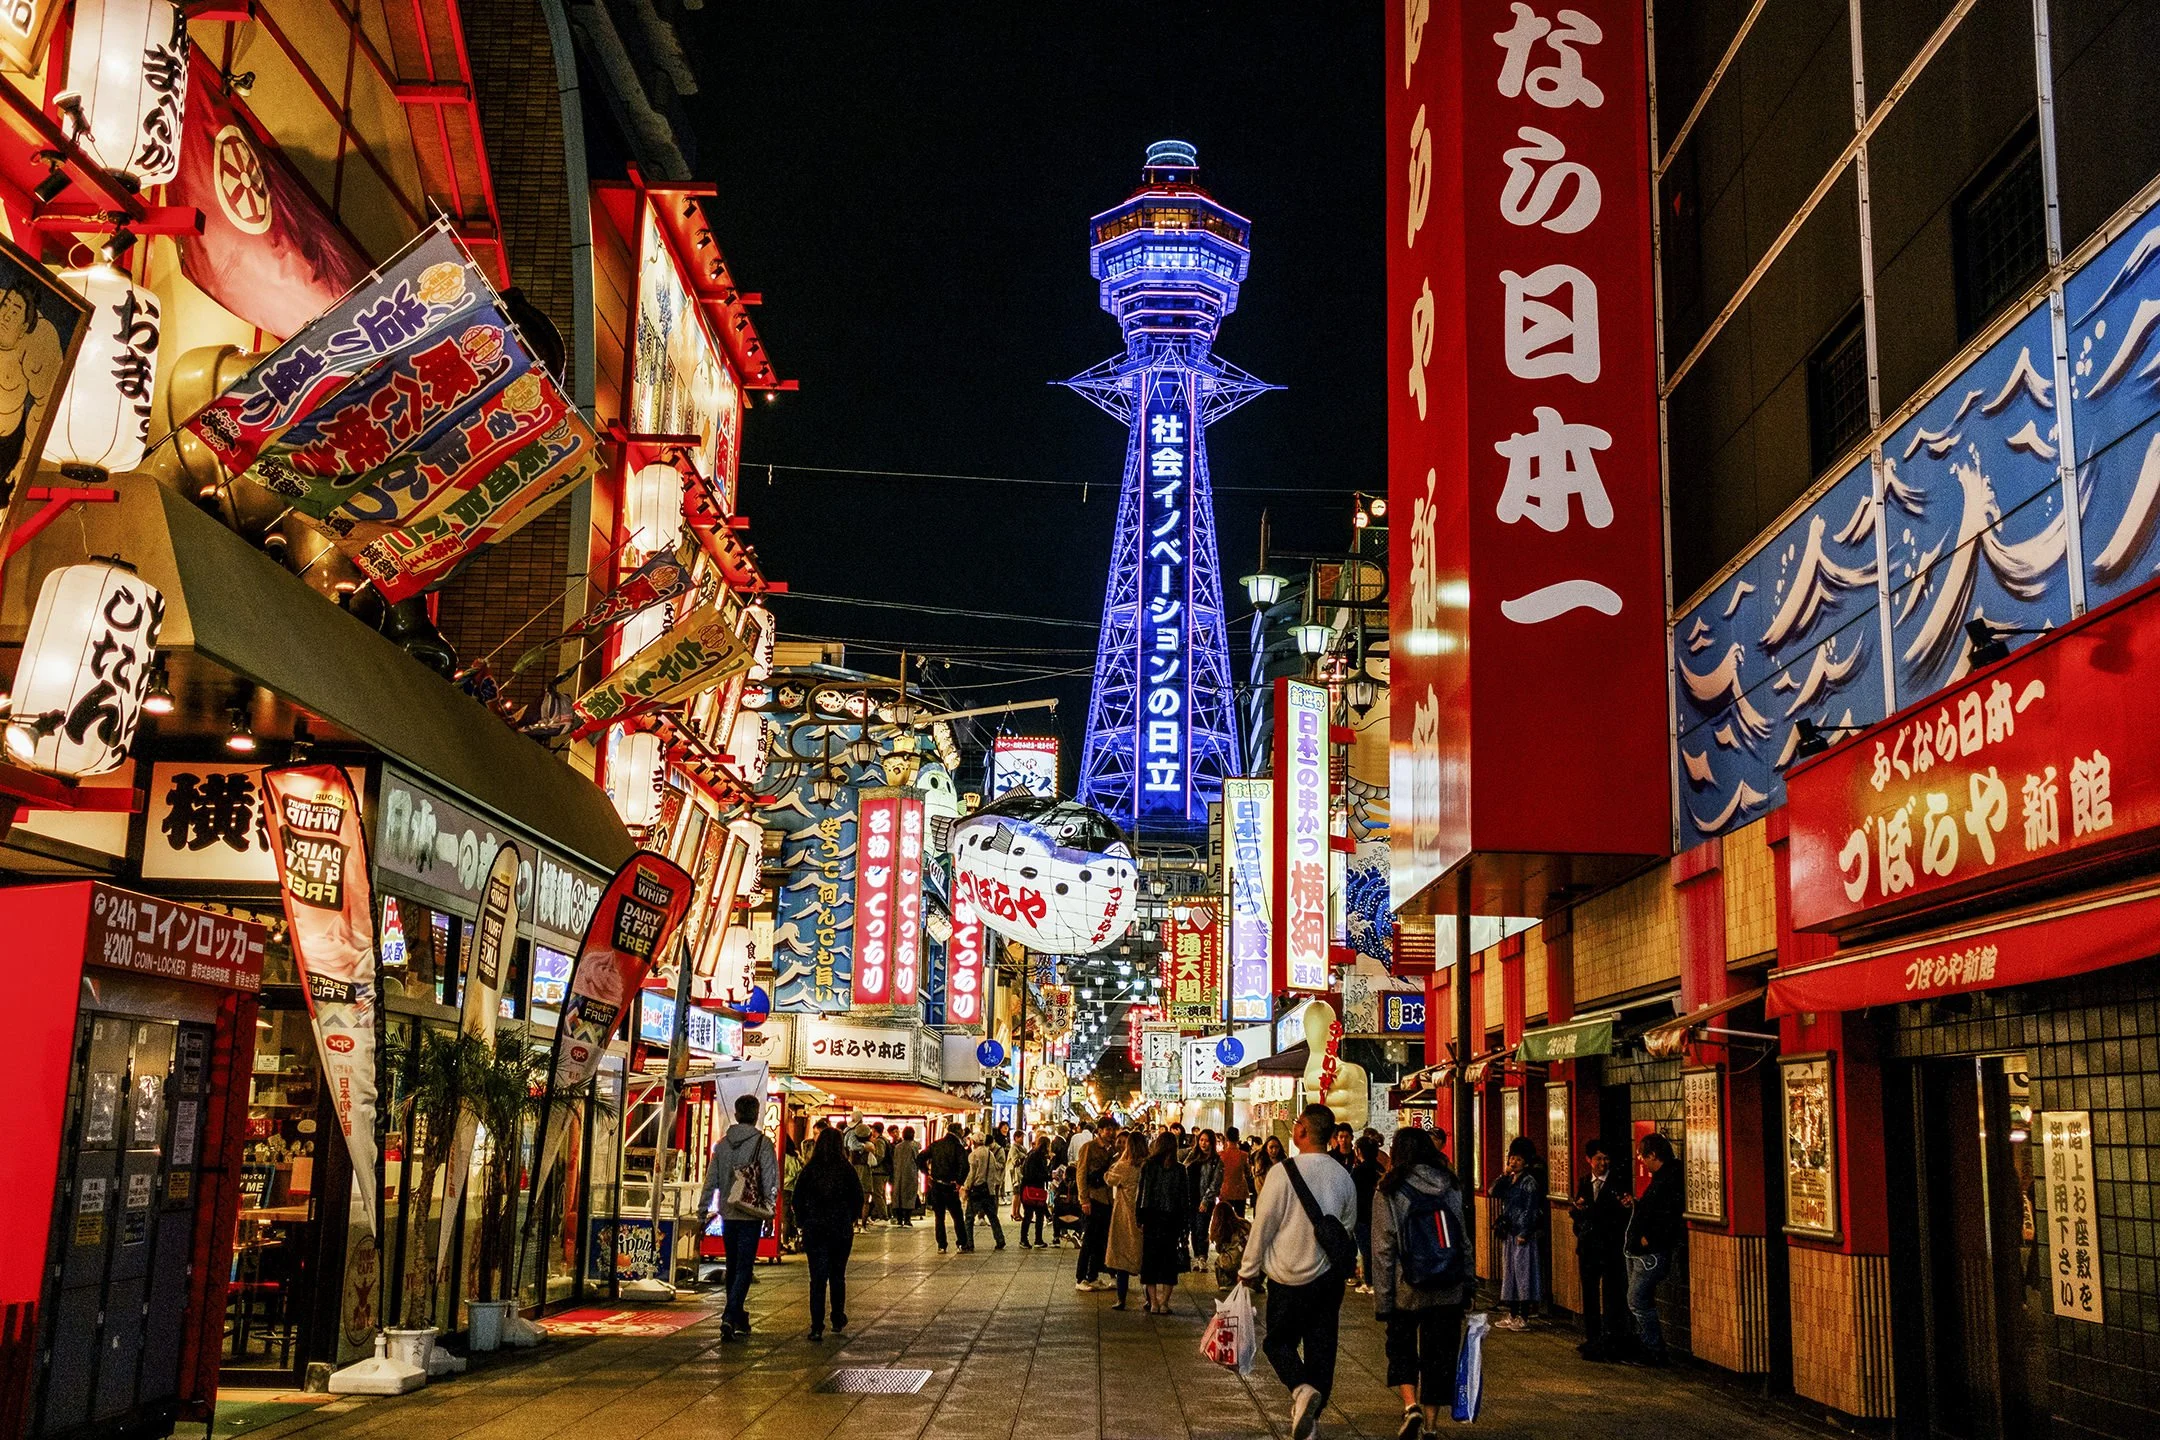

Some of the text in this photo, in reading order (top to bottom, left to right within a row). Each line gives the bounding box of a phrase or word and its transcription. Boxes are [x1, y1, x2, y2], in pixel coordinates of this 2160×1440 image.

[1494, 2, 1622, 625] なら日本一
[1145, 414, 1184, 792] 社会イノベーションの日立
[1870, 679, 2045, 792] ふぐなら日本一
[1296, 711, 1319, 857] 日本一の串かつ
[2021, 749, 2113, 851] 新館
[161, 772, 269, 853] 横
[106, 896, 137, 932] 24h
[623, 902, 661, 926] DAIRY
[637, 883, 668, 905] WHIP
[1291, 860, 1325, 960] 横綱
[103, 932, 133, 967] ¥200
[137, 902, 264, 965] コインロッカー
[618, 934, 652, 956] FREE
[632, 919, 659, 940] FAT
[134, 951, 187, 976] COIN-LOCKER
[1176, 932, 1202, 1003] 通天閣
[1202, 932, 1212, 1003] TSUTENKAKU
[1294, 964, 1323, 985] 酒処
[1905, 944, 1998, 991] づぼらや新館
[584, 1008, 614, 1025] FRUIT
[812, 1037, 906, 1061] づぼらや本店
[2050, 1121, 2074, 1308] 御利用下さい
